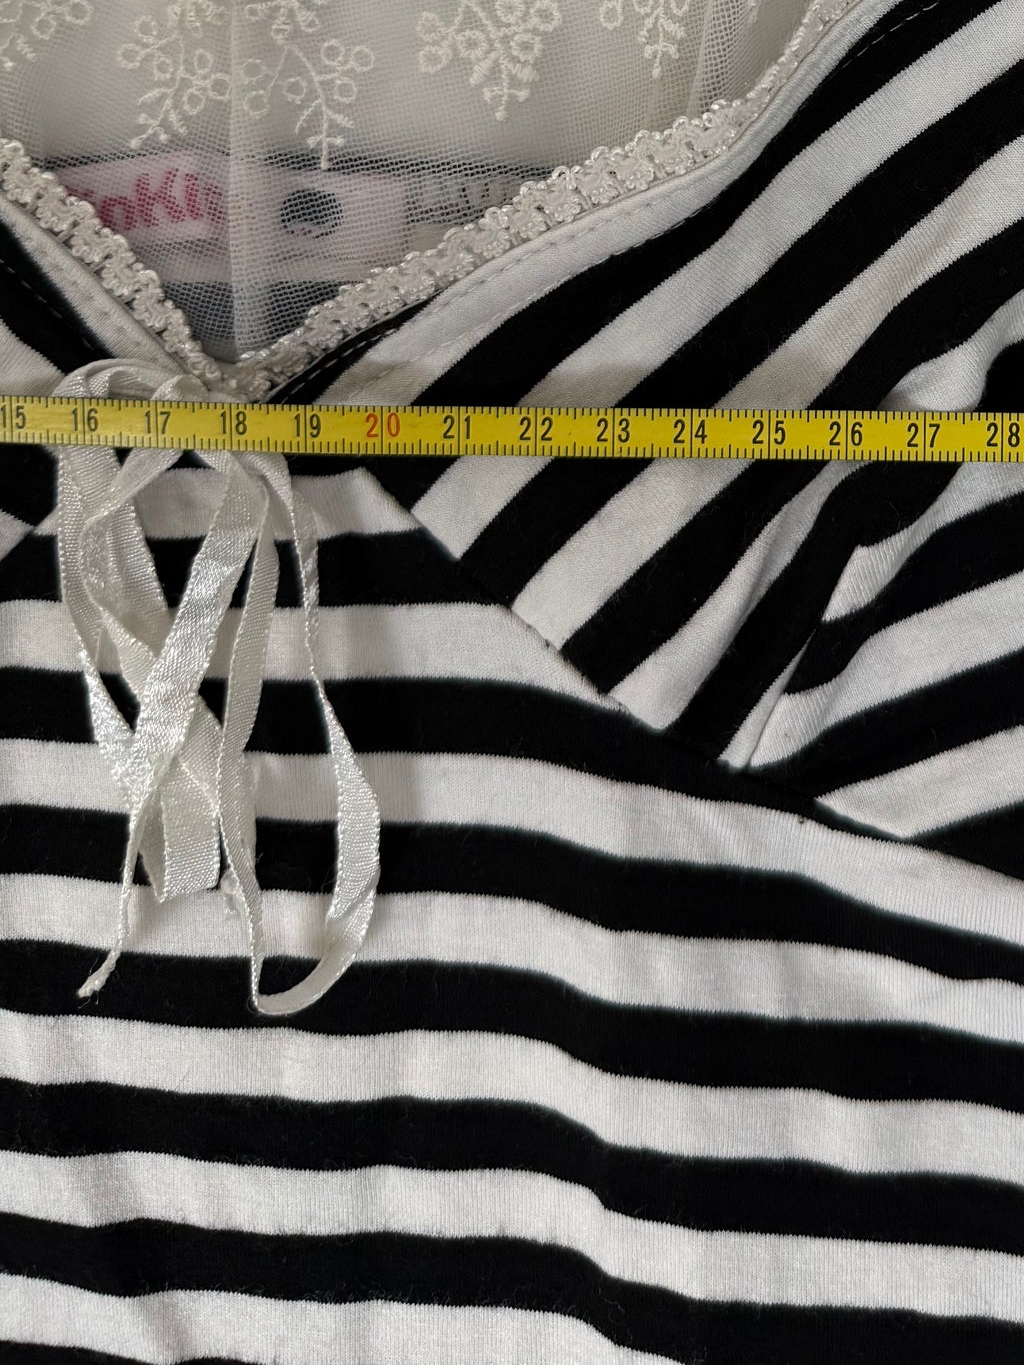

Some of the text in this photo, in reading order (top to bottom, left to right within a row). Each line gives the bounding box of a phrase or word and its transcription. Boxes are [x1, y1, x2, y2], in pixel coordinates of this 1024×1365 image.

[0, 404, 27, 430] 15
[71, 407, 99, 433] 16
[144, 409, 171, 435] 17
[219, 410, 248, 436] 18
[293, 412, 322, 439] 19
[364, 413, 401, 438] 20
[442, 414, 471, 440] 21
[518, 415, 554, 442] 22
[596, 417, 631, 444] 23
[672, 418, 708, 445] 24
[751, 418, 787, 446] 25
[828, 420, 864, 447] 26
[906, 422, 941, 449] 27
[986, 421, 1021, 448] 28
